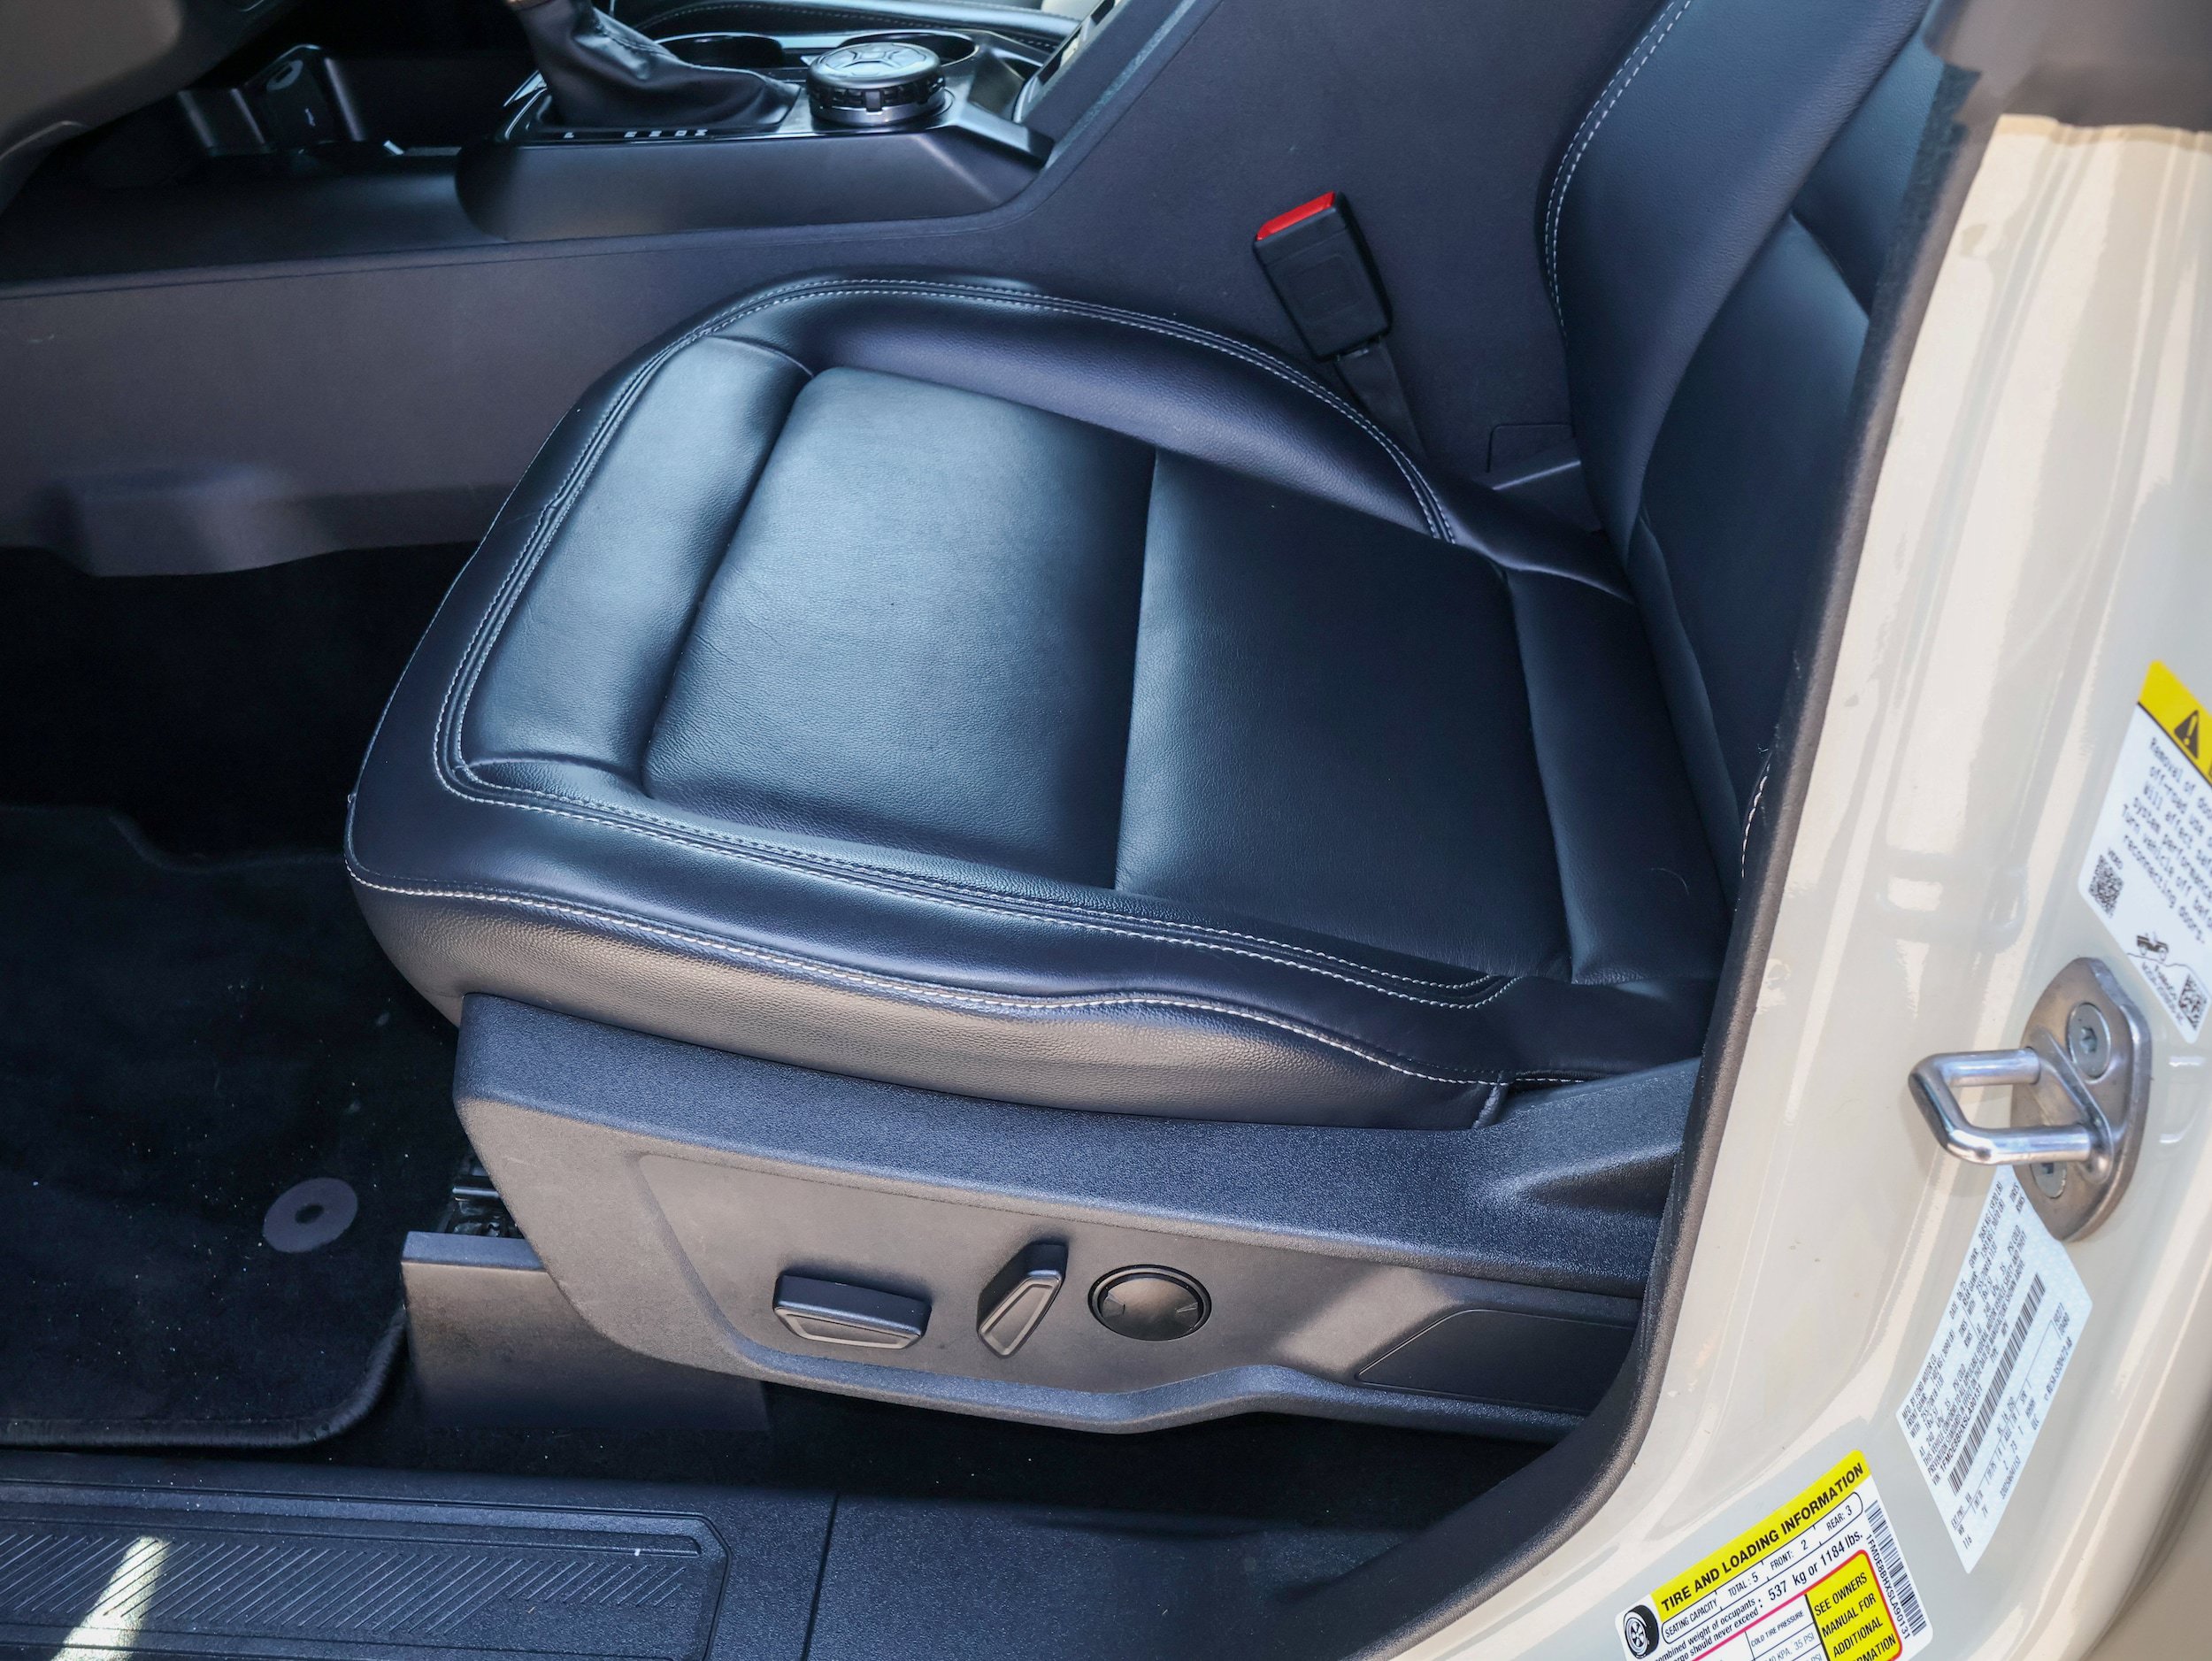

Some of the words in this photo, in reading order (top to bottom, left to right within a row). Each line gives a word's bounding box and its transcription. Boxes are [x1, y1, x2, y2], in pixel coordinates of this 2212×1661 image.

[1661, 1585, 1692, 1612] TIRE
[1692, 1565, 1720, 1592] AND
[1722, 1527, 1779, 1573] LOADING
[1780, 1462, 1863, 1534] INFORMATION
[1825, 1511, 1845, 1531] REAR:
[1845, 1503, 1852, 1516] 3
[1767, 1579, 1788, 1601] 537
[1792, 1571, 1807, 1585] kg
[1807, 1562, 1819, 1576] or
[1820, 1540, 1845, 1565] 1184
[1844, 1528, 1863, 1548] lbs.
[1770, 1549, 1793, 1570] FRONT:
[1800, 1538, 1808, 1550] 2
[1750, 1571, 1759, 1583] 5
[1813, 1597, 1832, 1616] SEE
[1832, 1571, 1867, 1604] OWNERS
[1866, 1534, 1911, 1639] 1FMDE8BHXSLA90131
[1664, 1616, 1689, 1638] SEATING
[1688, 1597, 1718, 1622] CAPACITY
[1687, 1625, 1710, 1646] weight
[1710, 1619, 1719, 1630] of
[1719, 1597, 1755, 1625] occupants
[1689, 1635, 1712, 1656] should
[1713, 1625, 1732, 1641] never
[1733, 1606, 1758, 1628] exceed
[1750, 1634, 1764, 1647] COLD
[1764, 1626, 1776, 1638] TIRE
[1777, 1610, 1803, 1630] PRESSURE
[1821, 1605, 1858, 1638] MANUAL
[1858, 1592, 1876, 1612] FOR
[1832, 1614, 1883, 1657] ADDITIONAL
[1794, 1640, 1803, 1649] 35
[1803, 1632, 1814, 1644] PSI
